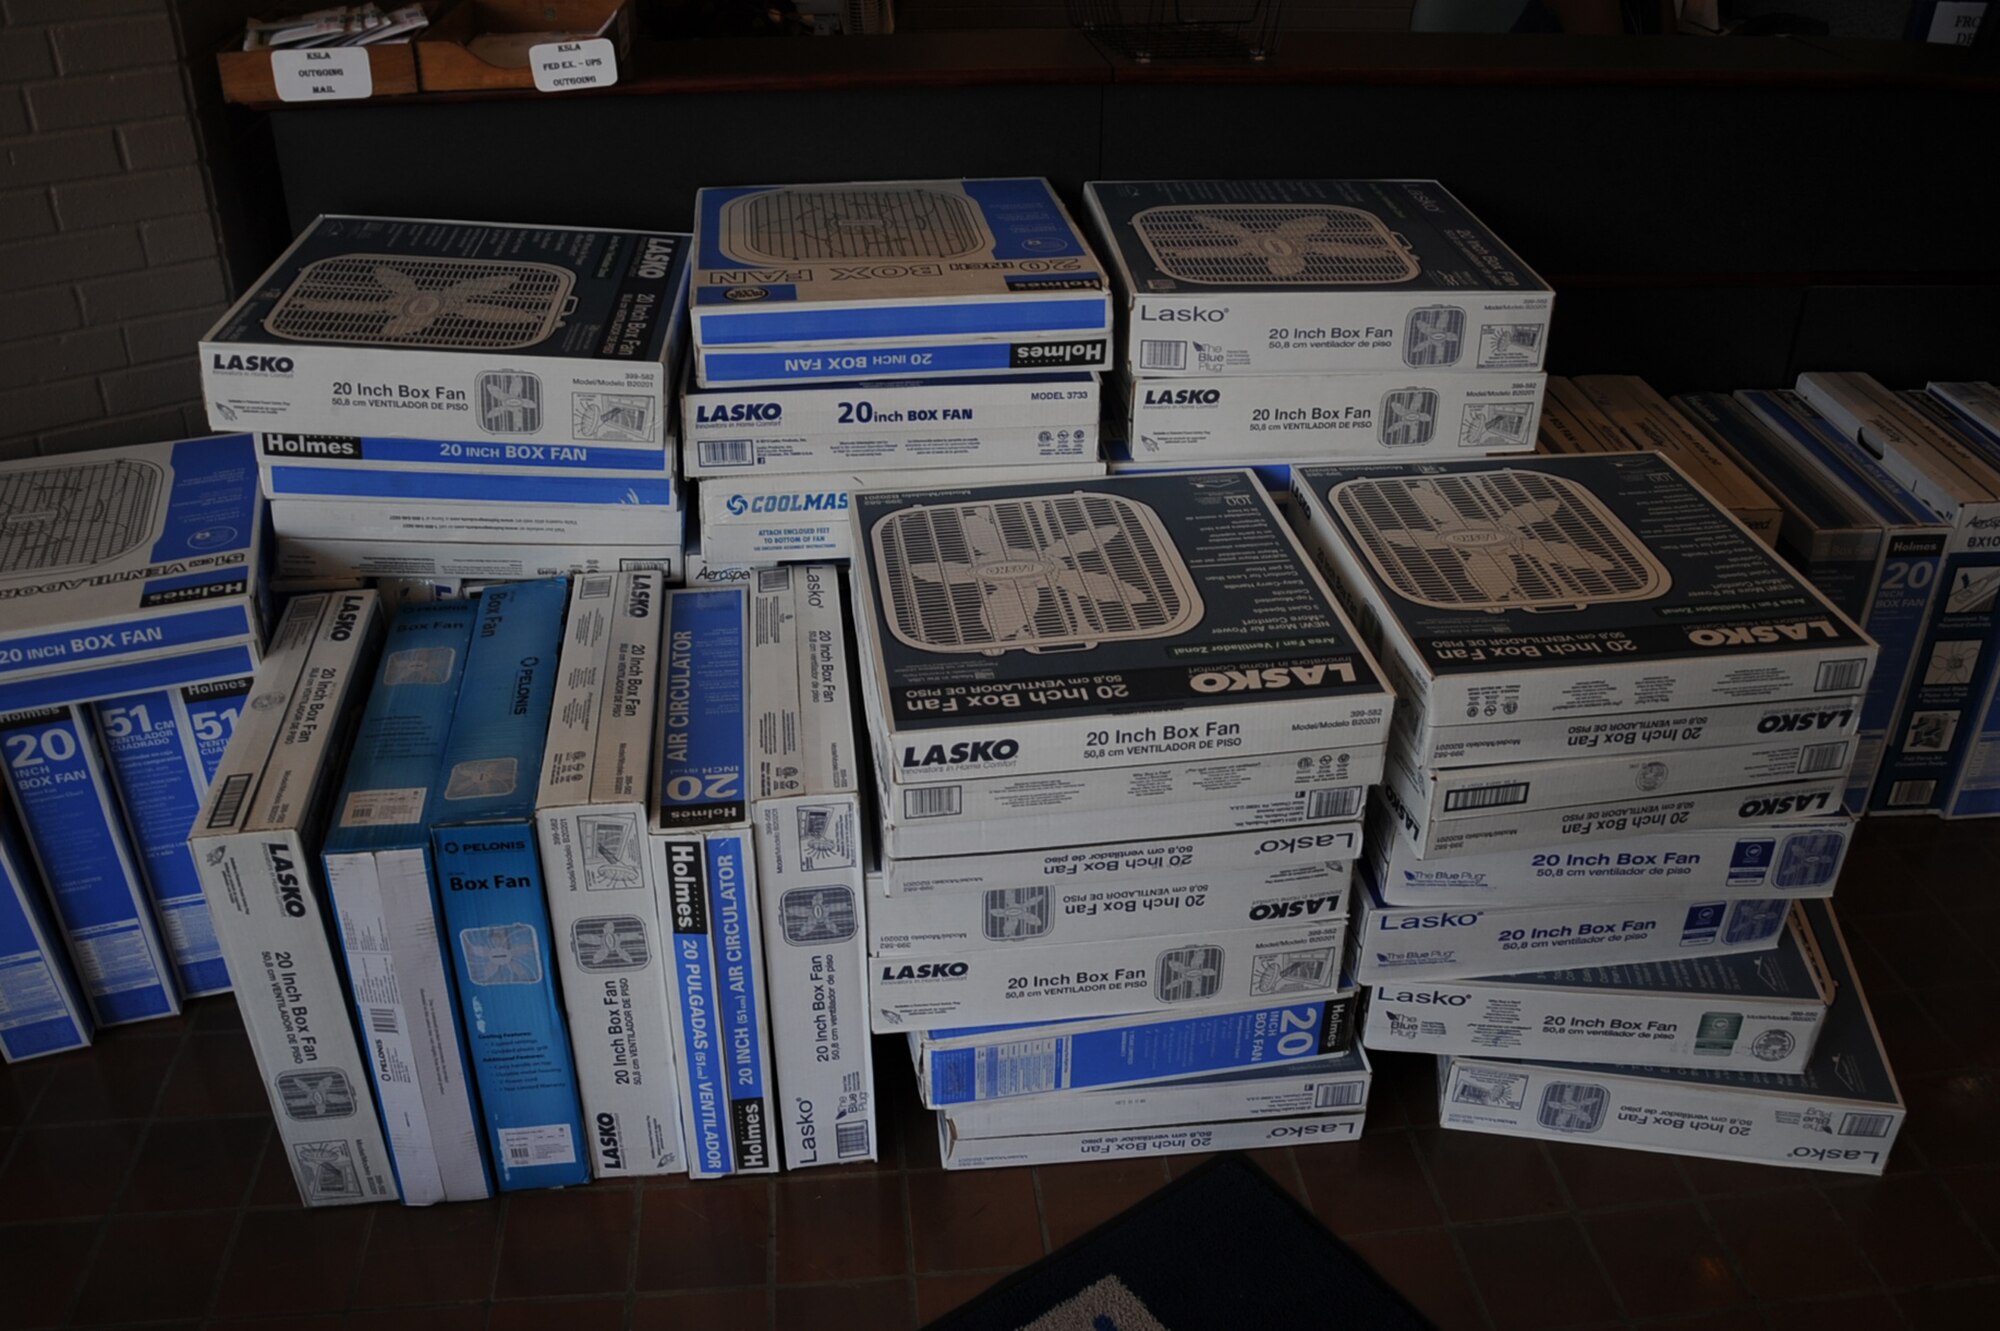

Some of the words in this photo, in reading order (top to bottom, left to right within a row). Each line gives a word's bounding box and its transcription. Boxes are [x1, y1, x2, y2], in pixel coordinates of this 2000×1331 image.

[307, 52, 330, 60] KSLA
[558, 43, 580, 52] KSLA
[298, 69, 343, 77] OUTGOING
[543, 62, 560, 71] FED
[586, 58, 601, 66] UPS
[553, 76, 596, 86] OUTGOING
[638, 238, 674, 278] LASKO
[1010, 279, 1110, 291] Holmes
[1270, 328, 1289, 340] 20
[1294, 328, 1325, 339] Inch
[1331, 328, 1361, 339] Box
[1366, 327, 1393, 338] Fan
[873, 354, 907, 365] INCH
[911, 353, 932, 365] 20
[1017, 343, 1100, 361] Holmes
[214, 354, 294, 373] LASKO
[785, 358, 822, 371] FAN
[828, 356, 867, 369] BOX
[333, 382, 353, 395] 20
[358, 383, 392, 397] Inch
[398, 385, 431, 399] Box
[435, 386, 466, 400] Fan
[1031, 392, 1064, 400] MODEL
[1067, 391, 1088, 399] 3733
[1145, 390, 1220, 404] LASKO
[697, 403, 782, 422] LASKO
[908, 408, 938, 421] BOX
[943, 408, 973, 420] FAN
[267, 437, 354, 454] Holmes
[440, 444, 461, 457] 20
[466, 447, 499, 458] INCH
[506, 446, 545, 459] BOX
[551, 447, 586, 461] FAN
[1893, 542, 1937, 552] Holmes
[1881, 561, 1933, 589] 20
[150, 582, 243, 600] Holmes
[1875, 600, 1898, 608] BOX
[1902, 599, 1925, 607] FAN
[331, 596, 363, 641] LASKO
[1688, 617, 1842, 647] LASKO
[0, 649, 22, 664] 20
[27, 644, 65, 660] INCH
[70, 634, 116, 652] BOX
[120, 627, 163, 644] FAN
[1174, 647, 1209, 655] Zonal
[1212, 642, 1273, 652] Ventilador
[189, 679, 247, 696] Holmes
[668, 631, 692, 727] CIRCULATOR
[1191, 668, 1357, 692] LASKO
[102, 705, 152, 737] 51
[155, 721, 174, 730] CM
[1351, 709, 1383, 717] 399-582
[1757, 708, 1854, 734] LASKO
[1087, 730, 1109, 746] 20
[1116, 728, 1158, 744] Inch
[1164, 725, 1199, 741] Box
[1206, 722, 1240, 737] Fan
[1292, 720, 1349, 731] Model/Modelo
[1352, 717, 1381, 726] B20201
[6, 728, 75, 768] 20
[109, 730, 173, 746] VENTILADOR
[112, 738, 169, 752] CUADRADO
[667, 732, 688, 762] AIR
[1106, 747, 1122, 757] cm
[1125, 741, 1198, 756] VENTILADOR
[1200, 739, 1214, 749] DE
[1216, 737, 1241, 747] PISO
[903, 739, 1019, 768] LASKO
[15, 766, 49, 778] INCH
[18, 777, 53, 790] BOX
[55, 770, 86, 784] FAN
[667, 773, 739, 801] 20
[671, 807, 736, 819] Holmes
[1738, 793, 1830, 818] LASKO
[463, 840, 525, 851] PELONIS
[1532, 853, 1560, 867] 20
[1566, 852, 1611, 867] Inch
[1616, 851, 1659, 865] Box
[1663, 851, 1701, 864] Fan
[269, 843, 305, 917] LASKO
[451, 877, 488, 892] Box
[495, 875, 531, 889] Fan
[671, 845, 693, 928] Holmes
[718, 854, 741, 961] CIRCULATOR
[1250, 895, 1340, 921] LASKO
[1498, 929, 1525, 942] 20
[1530, 926, 1572, 940] Inch
[1578, 922, 1615, 936] Box
[1621, 919, 1656, 933] Fan
[275, 951, 293, 968] 20
[682, 940, 697, 960] 20
[811, 956, 821, 981] Fan
[883, 962, 969, 981] LASKO
[1008, 976, 1028, 989] 20
[1033, 972, 1071, 987] Inch
[1076, 970, 1110, 985] Box
[1115, 968, 1146, 981] Fan
[281, 973, 302, 1002] Inch
[728, 965, 744, 993] AIR
[604, 981, 618, 1005] Fan
[813, 986, 825, 1010] Box
[685, 964, 709, 1050] PULGADAS
[292, 1007, 309, 1032] Box
[608, 1009, 623, 1034] Box
[816, 1015, 826, 1043] Inch
[1255, 1012, 1267, 1037] BOX
[1268, 1011, 1279, 1037] INCH
[1327, 1004, 1345, 1047] Holmes
[1390, 1021, 1418, 1031] Blue
[1277, 1007, 1317, 1056] 20
[301, 1037, 317, 1061] Fan
[610, 1039, 627, 1066] Inch
[736, 1028, 750, 1062] INCH
[817, 1048, 828, 1062] 20
[1251, 1039, 1264, 1061] FAN
[615, 1070, 630, 1084] 20
[739, 1066, 752, 1085] 20
[699, 1082, 722, 1170] VENTILADOR
[744, 1103, 759, 1169] Holmes
[597, 1113, 621, 1168] LASKO
